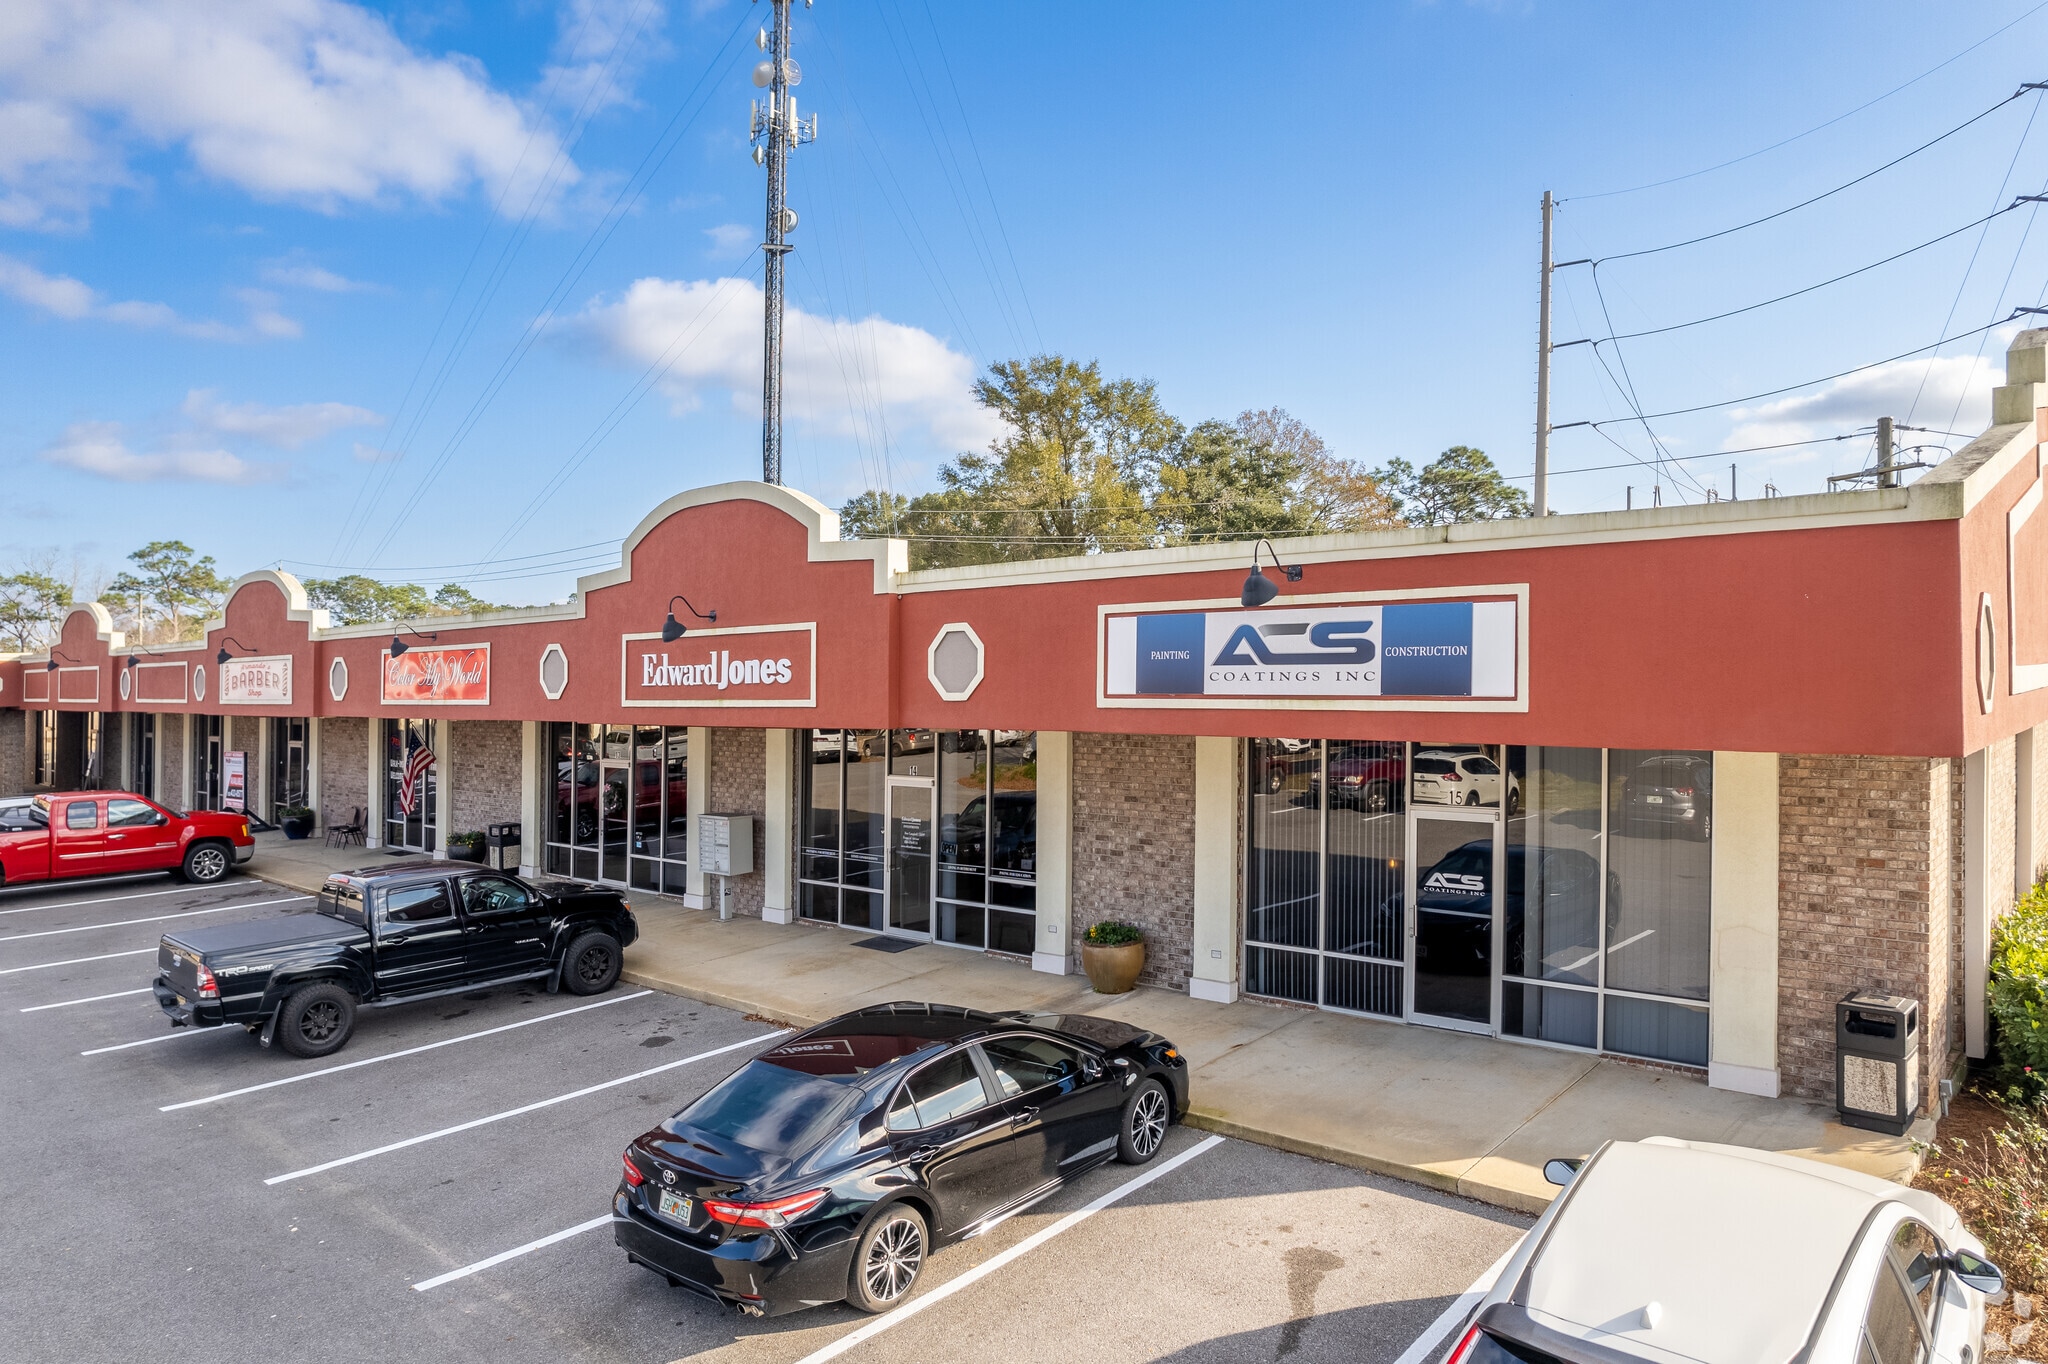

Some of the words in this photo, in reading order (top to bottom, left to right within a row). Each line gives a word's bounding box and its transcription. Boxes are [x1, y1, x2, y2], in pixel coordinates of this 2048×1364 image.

[1211, 620, 1376, 666] ACS
[1150, 650, 1190, 660] PAINTING
[1384, 645, 1468, 657] CONSTRUCTION
[231, 670, 280, 690] BARBER
[386, 658, 416, 687] Color
[417, 656, 446, 697] My
[444, 651, 485, 686] World
[1209, 671, 1321, 682] COATINGS
[1335, 671, 1376, 681] INC
[909, 765, 918, 776] 14
[1449, 790, 1463, 805] 15
[941, 842, 957, 855] OPEN
[1425, 872, 1485, 891] ACS
[1423, 886, 1467, 895] COATINGS
